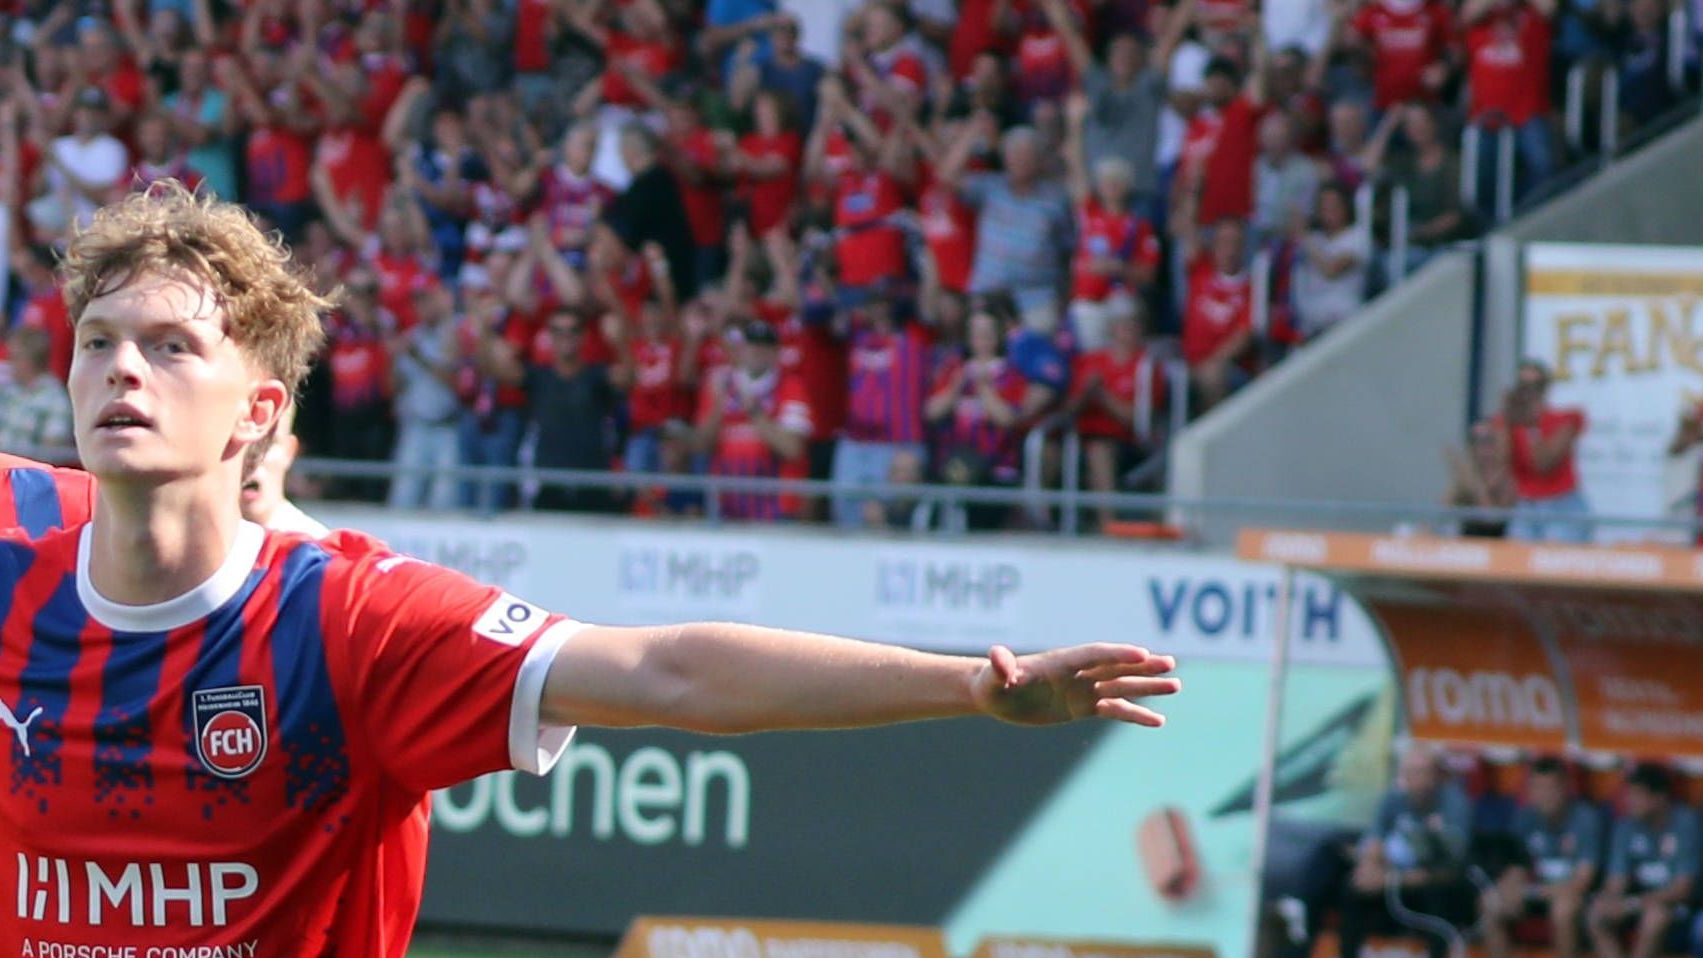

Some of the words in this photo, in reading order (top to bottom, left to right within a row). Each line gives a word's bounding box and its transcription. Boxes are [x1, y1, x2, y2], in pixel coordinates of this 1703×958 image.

[1409, 666, 1563, 728] roma
[210, 728, 253, 756] FCH
[85, 861, 259, 926] MHP
[22, 938, 34, 958] A
